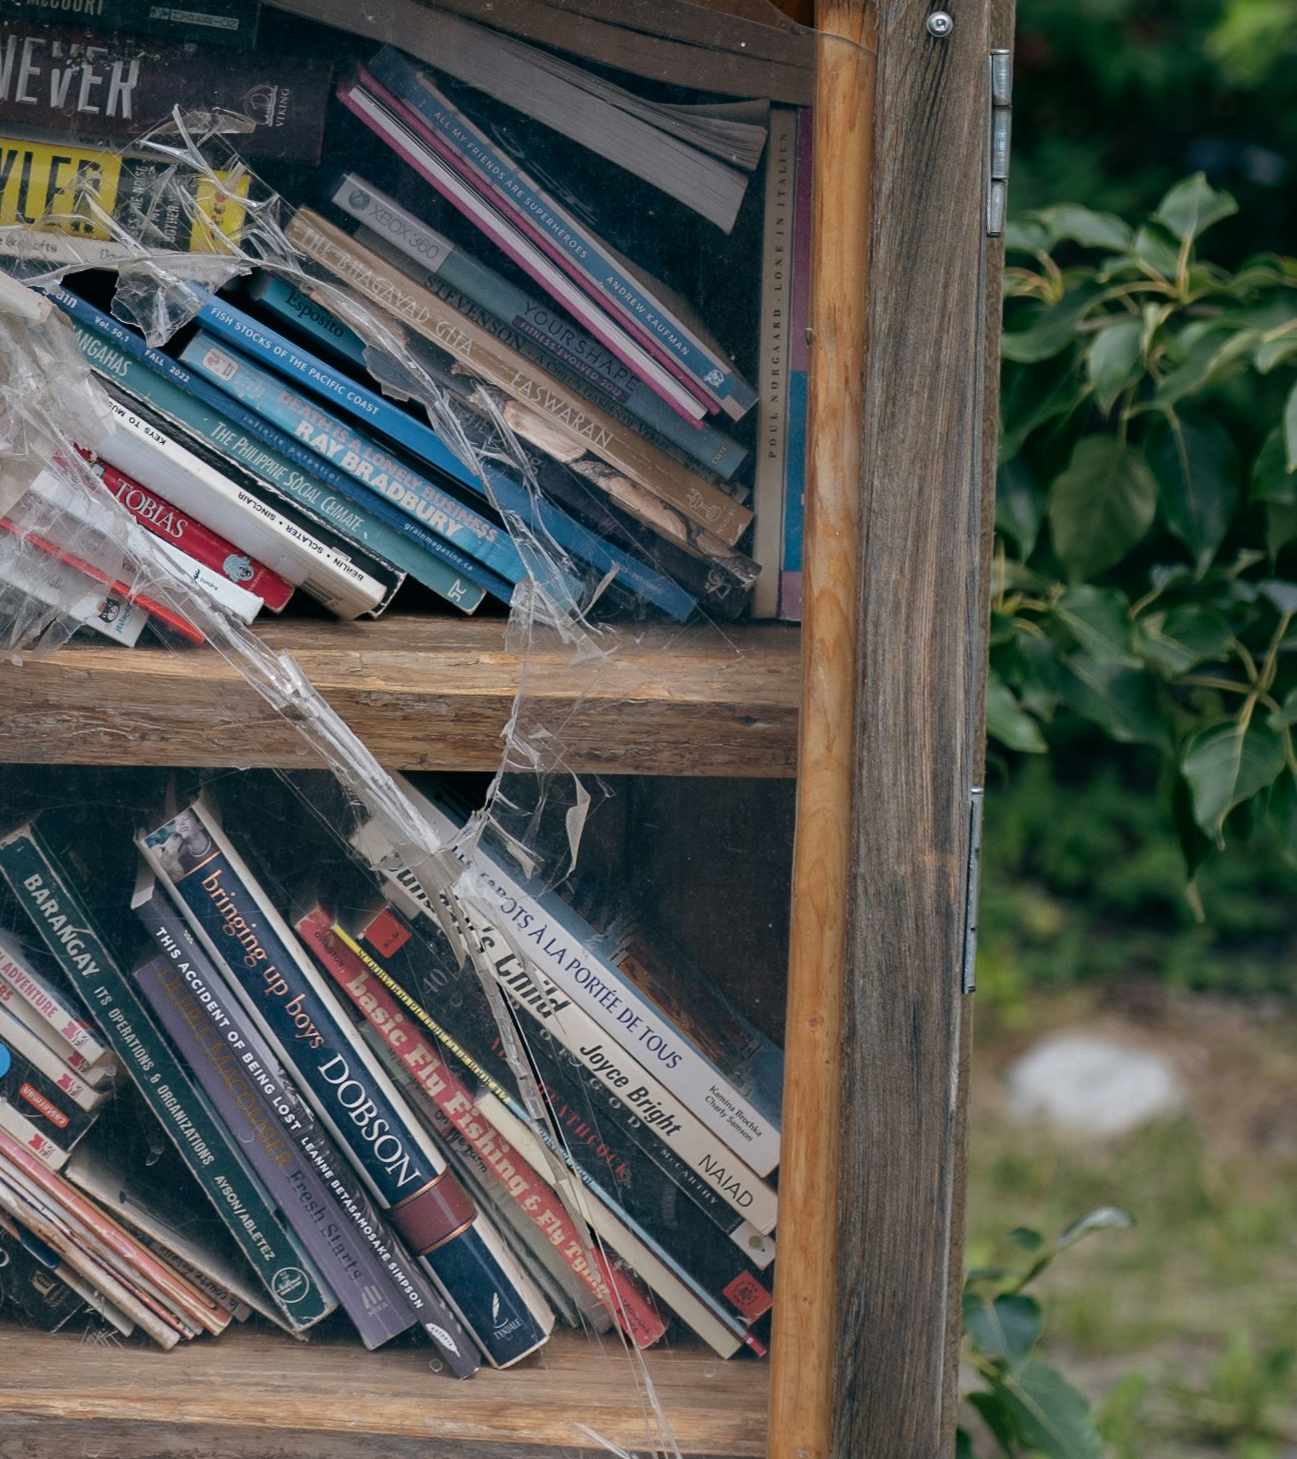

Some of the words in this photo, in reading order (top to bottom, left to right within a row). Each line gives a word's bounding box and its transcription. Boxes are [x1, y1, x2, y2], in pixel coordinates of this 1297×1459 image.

[433, 111, 452, 130] ALL
[452, 127, 467, 146] MY
[465, 140, 506, 180] FRIENDS
[504, 179, 524, 199] ARE
[523, 196, 589, 259] SUPERHEROES
[605, 275, 646, 316] ANDREW
[645, 313, 690, 356] KAUFMAN
[210, 306, 233, 326] FISH
[234, 321, 272, 350] STOCKS
[273, 345, 289, 359] OF
[288, 354, 306, 372] THE
[308, 367, 347, 395] PACIFIC
[346, 391, 381, 416] COAST
[284, 290, 346, 339] Esposito
[423, 275, 526, 351] STEVENSON
[113, 478, 190, 539] TOBIAS
[294, 419, 345, 459] RAY
[340, 451, 466, 538] BRADBURY
[1, 960, 60, 1019] ADVENTURE
[201, 868, 268, 970] bringing
[262, 963, 290, 999] up
[283, 992, 326, 1051] boys
[317, 1052, 422, 1190] DOBSON
[529, 923, 546, 947] À
[542, 938, 566, 966] LA
[565, 957, 621, 1014] PORTÉE
[615, 1006, 643, 1033] DE
[637, 1026, 684, 1071] TOUS
[22, 873, 101, 978] BARANGAY
[93, 985, 110, 1007] ITS
[107, 1008, 155, 1073] OPERATIONS
[148, 1072, 161, 1084] &
[156, 1083, 215, 1168] ORGANIZATIONS
[213, 1174, 275, 1263] AYSON/ABLETEZ
[155, 926, 182, 960] THIS
[177, 961, 231, 1029] ACCIDENT
[227, 1030, 246, 1053] OF
[241, 1051, 276, 1096] BEING
[271, 1092, 302, 1131] LOST
[300, 1136, 335, 1181] LEANNE
[330, 1177, 394, 1263] BETASAMOSAKE
[387, 1260, 425, 1310] SIMPSON
[580, 1041, 630, 1091] Joyce
[626, 1085, 683, 1138] Bright
[708, 1084, 735, 1113] Kamina
[731, 1110, 764, 1137] Brochka
[697, 1153, 755, 1211] NAIAD
